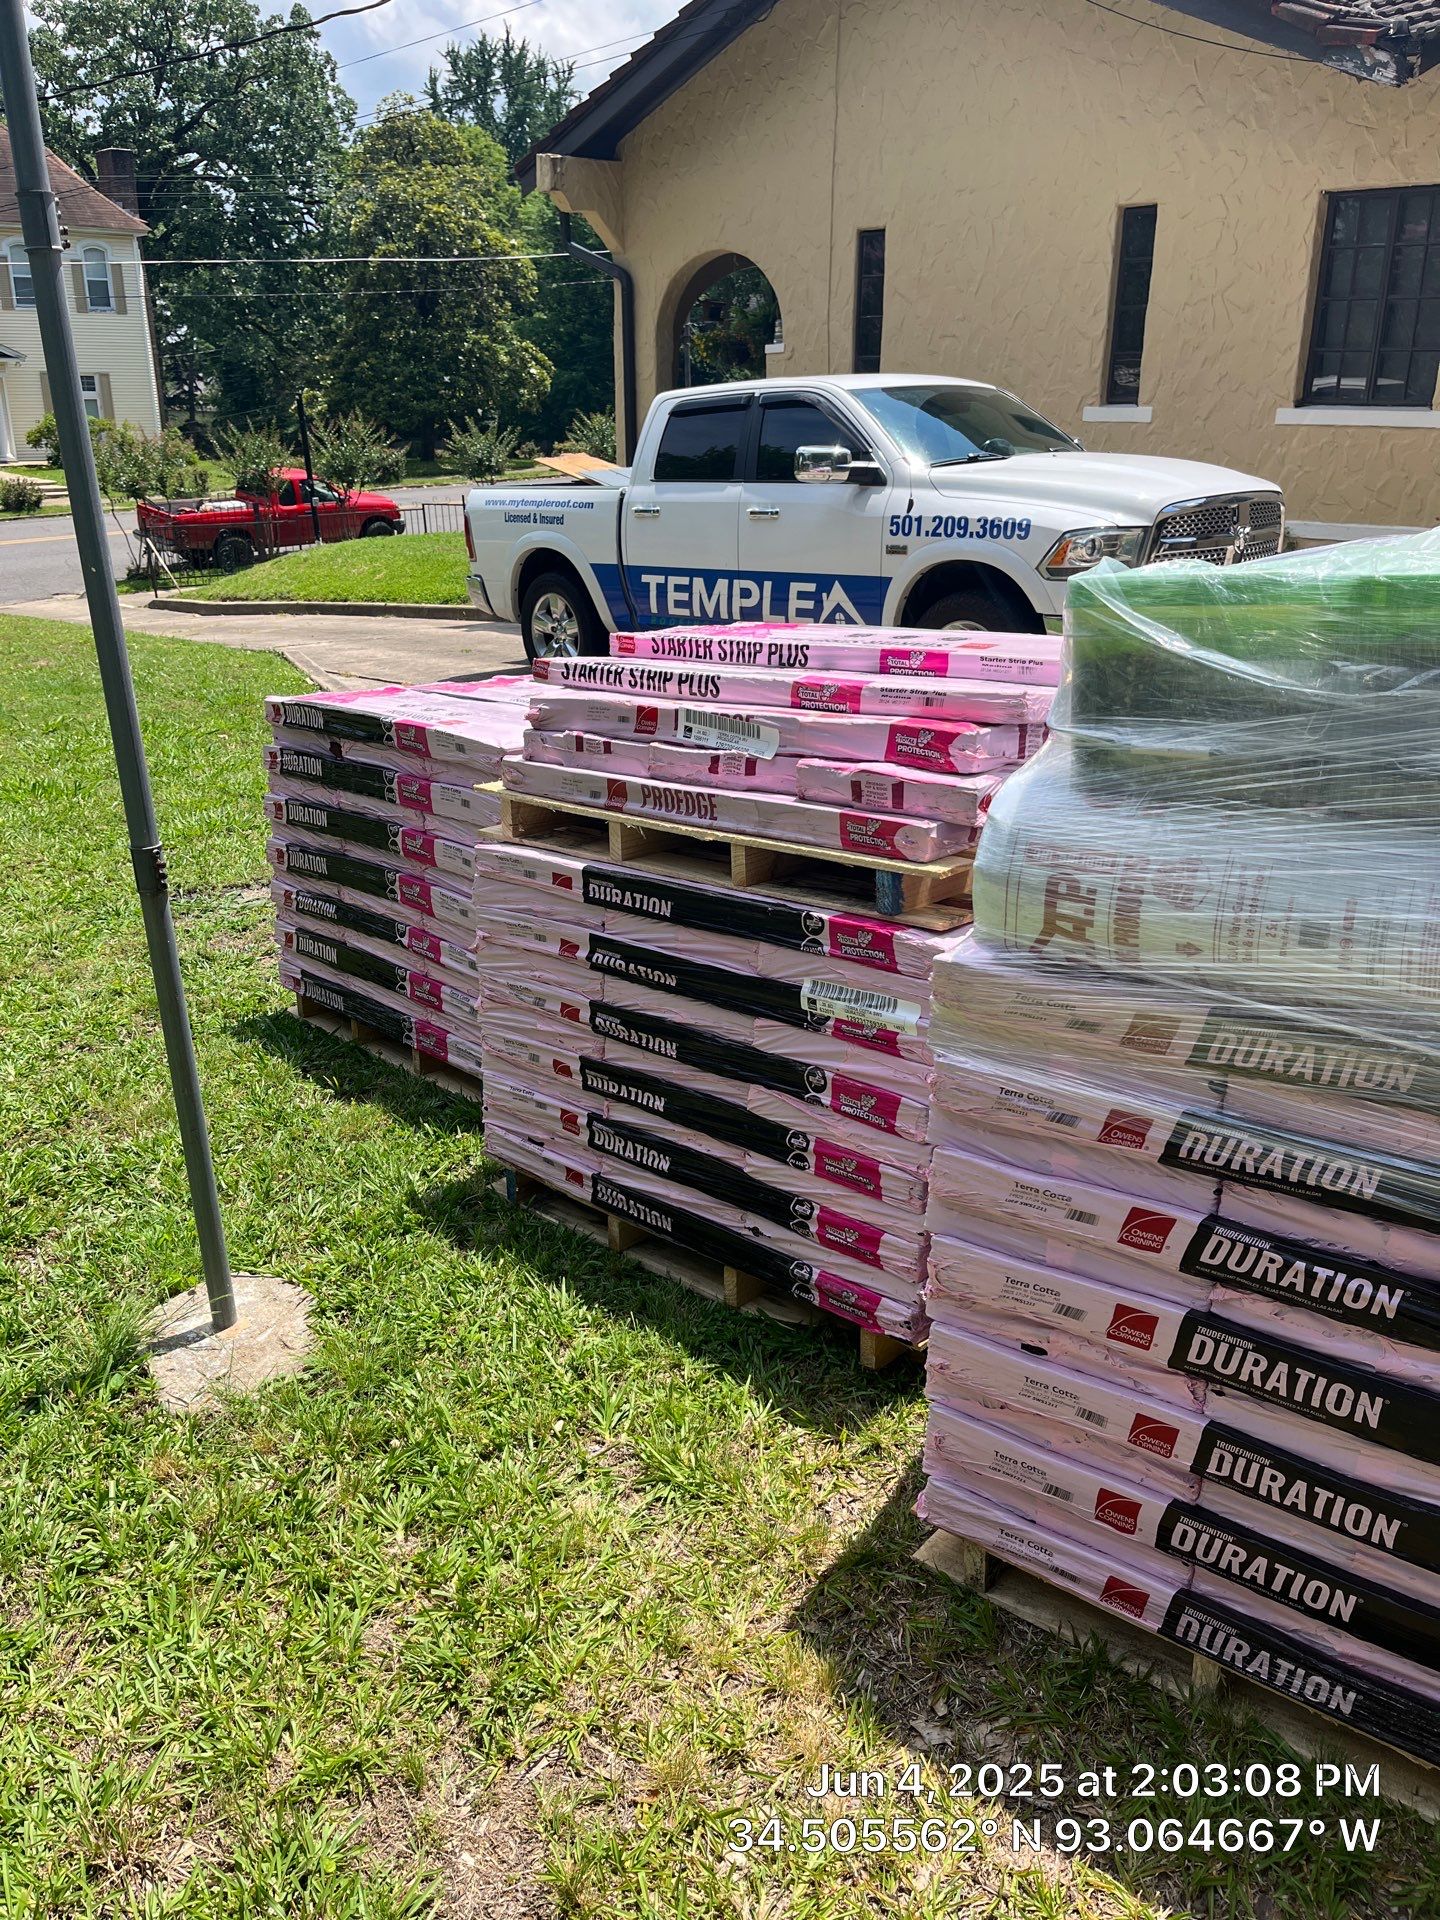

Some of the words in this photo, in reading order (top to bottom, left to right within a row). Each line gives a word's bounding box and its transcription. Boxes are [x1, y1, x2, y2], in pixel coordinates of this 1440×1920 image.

[484, 498, 594, 510] www.mytempleroof.com
[504, 512, 531, 524] Licensed
[532, 512, 538, 524] &
[539, 513, 564, 525] Insured
[889, 515, 1032, 540] 501.209.3609
[641, 574, 817, 624] TEMPLE
[652, 636, 713, 661] STARTER
[718, 639, 763, 664] STRIP
[768, 642, 809, 668] PLUS
[890, 658, 909, 667] TOTAL
[979, 656, 1006, 664] Starter
[561, 662, 624, 688] STARTER
[628, 667, 673, 693] STRIP
[677, 672, 721, 699] PLUS
[879, 686, 908, 694] Starter
[800, 690, 819, 700] TOTAL
[800, 700, 846, 712] PROTECTION
[285, 705, 324, 730] DURATION
[897, 745, 941, 759] PROTECTION
[899, 736, 916, 746] TOTAL
[282, 753, 323, 777] DURATION
[641, 784, 718, 821] PROEDGE
[288, 804, 328, 828] DURATION
[849, 824, 866, 833] TOTAL
[850, 833, 888, 848] PROTECTION
[288, 850, 328, 875] DURATION
[297, 895, 338, 920] DURATION
[299, 936, 338, 965] DURATION
[842, 945, 885, 959] PROTECTION
[305, 979, 345, 1012] DURATION
[1208, 1032, 1416, 1093] DURATION
[999, 1086, 1024, 1099] Terra
[841, 1105, 885, 1126] PROTECTION
[1101, 1135, 1141, 1149] CORNING
[1111, 1129, 1144, 1143] OWENS
[1178, 1130, 1384, 1200] DURATION
[1014, 1181, 1040, 1194] Terra
[1043, 1189, 1073, 1203] Cotta
[1122, 1232, 1162, 1249] CORNING
[1131, 1228, 1164, 1243] OWENS
[1213, 1225, 1271, 1250] TRUDEFINITION
[1005, 1275, 1030, 1289] Terra
[1033, 1283, 1062, 1297] Cotta
[1199, 1233, 1405, 1319] DURATION
[1109, 1328, 1150, 1346] CORNING
[1119, 1325, 1151, 1341] OWENS
[1196, 1325, 1254, 1350] TRUDEFINITION
[1024, 1375, 1050, 1390] Terra
[1052, 1385, 1079, 1400] Cotta
[1187, 1333, 1385, 1429] DURATION
[1131, 1437, 1170, 1457] CORNING
[1139, 1433, 1172, 1450] OWENS
[1216, 1439, 1272, 1466] TRUDEFINITION
[994, 1450, 1019, 1465] Terra
[1021, 1461, 1047, 1477] Cotta
[1206, 1447, 1401, 1549] DURATION
[1099, 1512, 1135, 1531] CORNING
[1105, 1508, 1135, 1524] OWENS
[1179, 1515, 1235, 1543] TRUDEFINITION
[999, 1528, 1025, 1544] Terra
[1027, 1540, 1055, 1558] Cotta
[1170, 1522, 1359, 1623] DURATION
[1111, 1595, 1142, 1615] OWENS
[1184, 1605, 1238, 1637] TRUDEFINITION
[1175, 1613, 1357, 1716] DURATION
